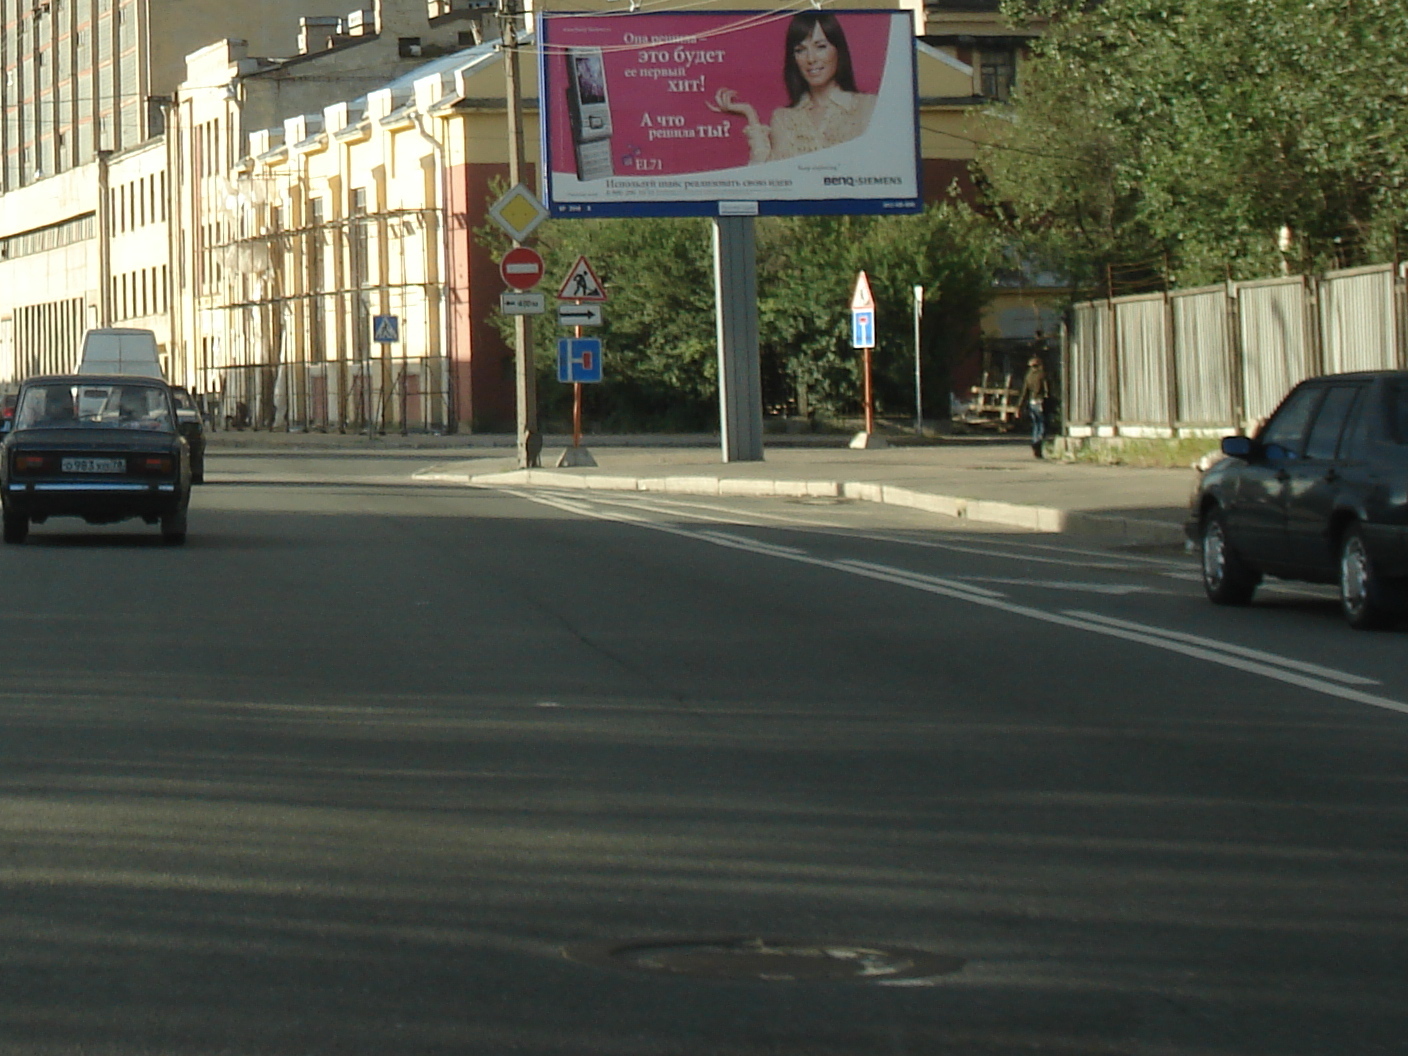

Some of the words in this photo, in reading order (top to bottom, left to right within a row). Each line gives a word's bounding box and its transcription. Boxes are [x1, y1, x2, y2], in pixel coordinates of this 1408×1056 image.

[638, 50, 669, 64] это
[673, 45, 726, 68] будет
[624, 68, 637, 78] ее
[639, 65, 686, 80] первый
[667, 74, 706, 93] хит!
[640, 112, 653, 127] А
[656, 115, 685, 127] что
[648, 128, 696, 142] решила
